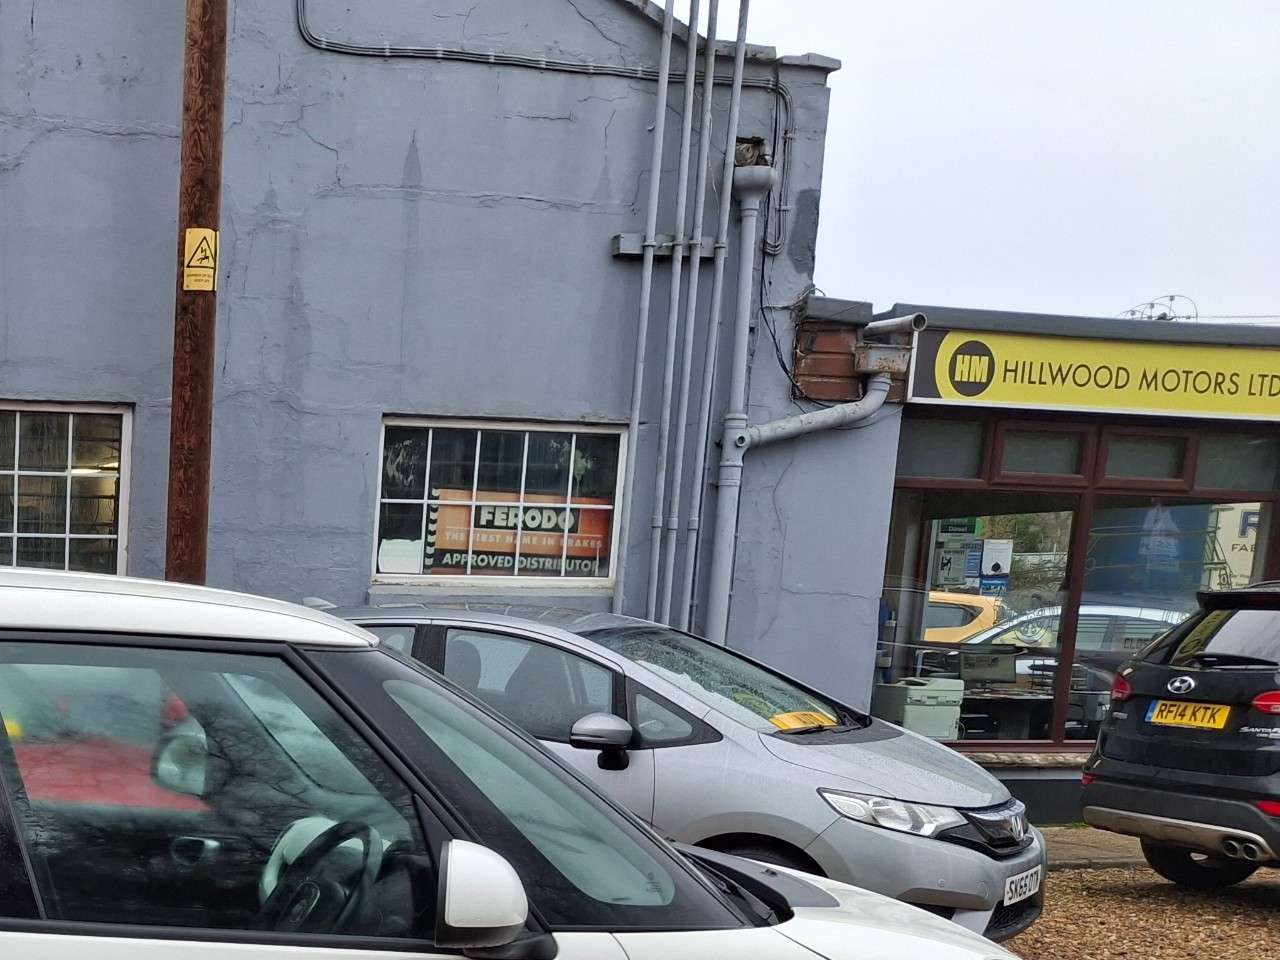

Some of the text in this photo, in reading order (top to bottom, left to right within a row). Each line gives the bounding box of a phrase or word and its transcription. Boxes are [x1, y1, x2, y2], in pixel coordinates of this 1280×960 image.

[954, 354, 990, 383] HM
[1002, 359, 1280, 397] HILLWOOD MOTORS LTD
[480, 506, 575, 529] FERODO
[442, 552, 514, 568] APPROVED
[1156, 703, 1221, 724] RF14 KTK
